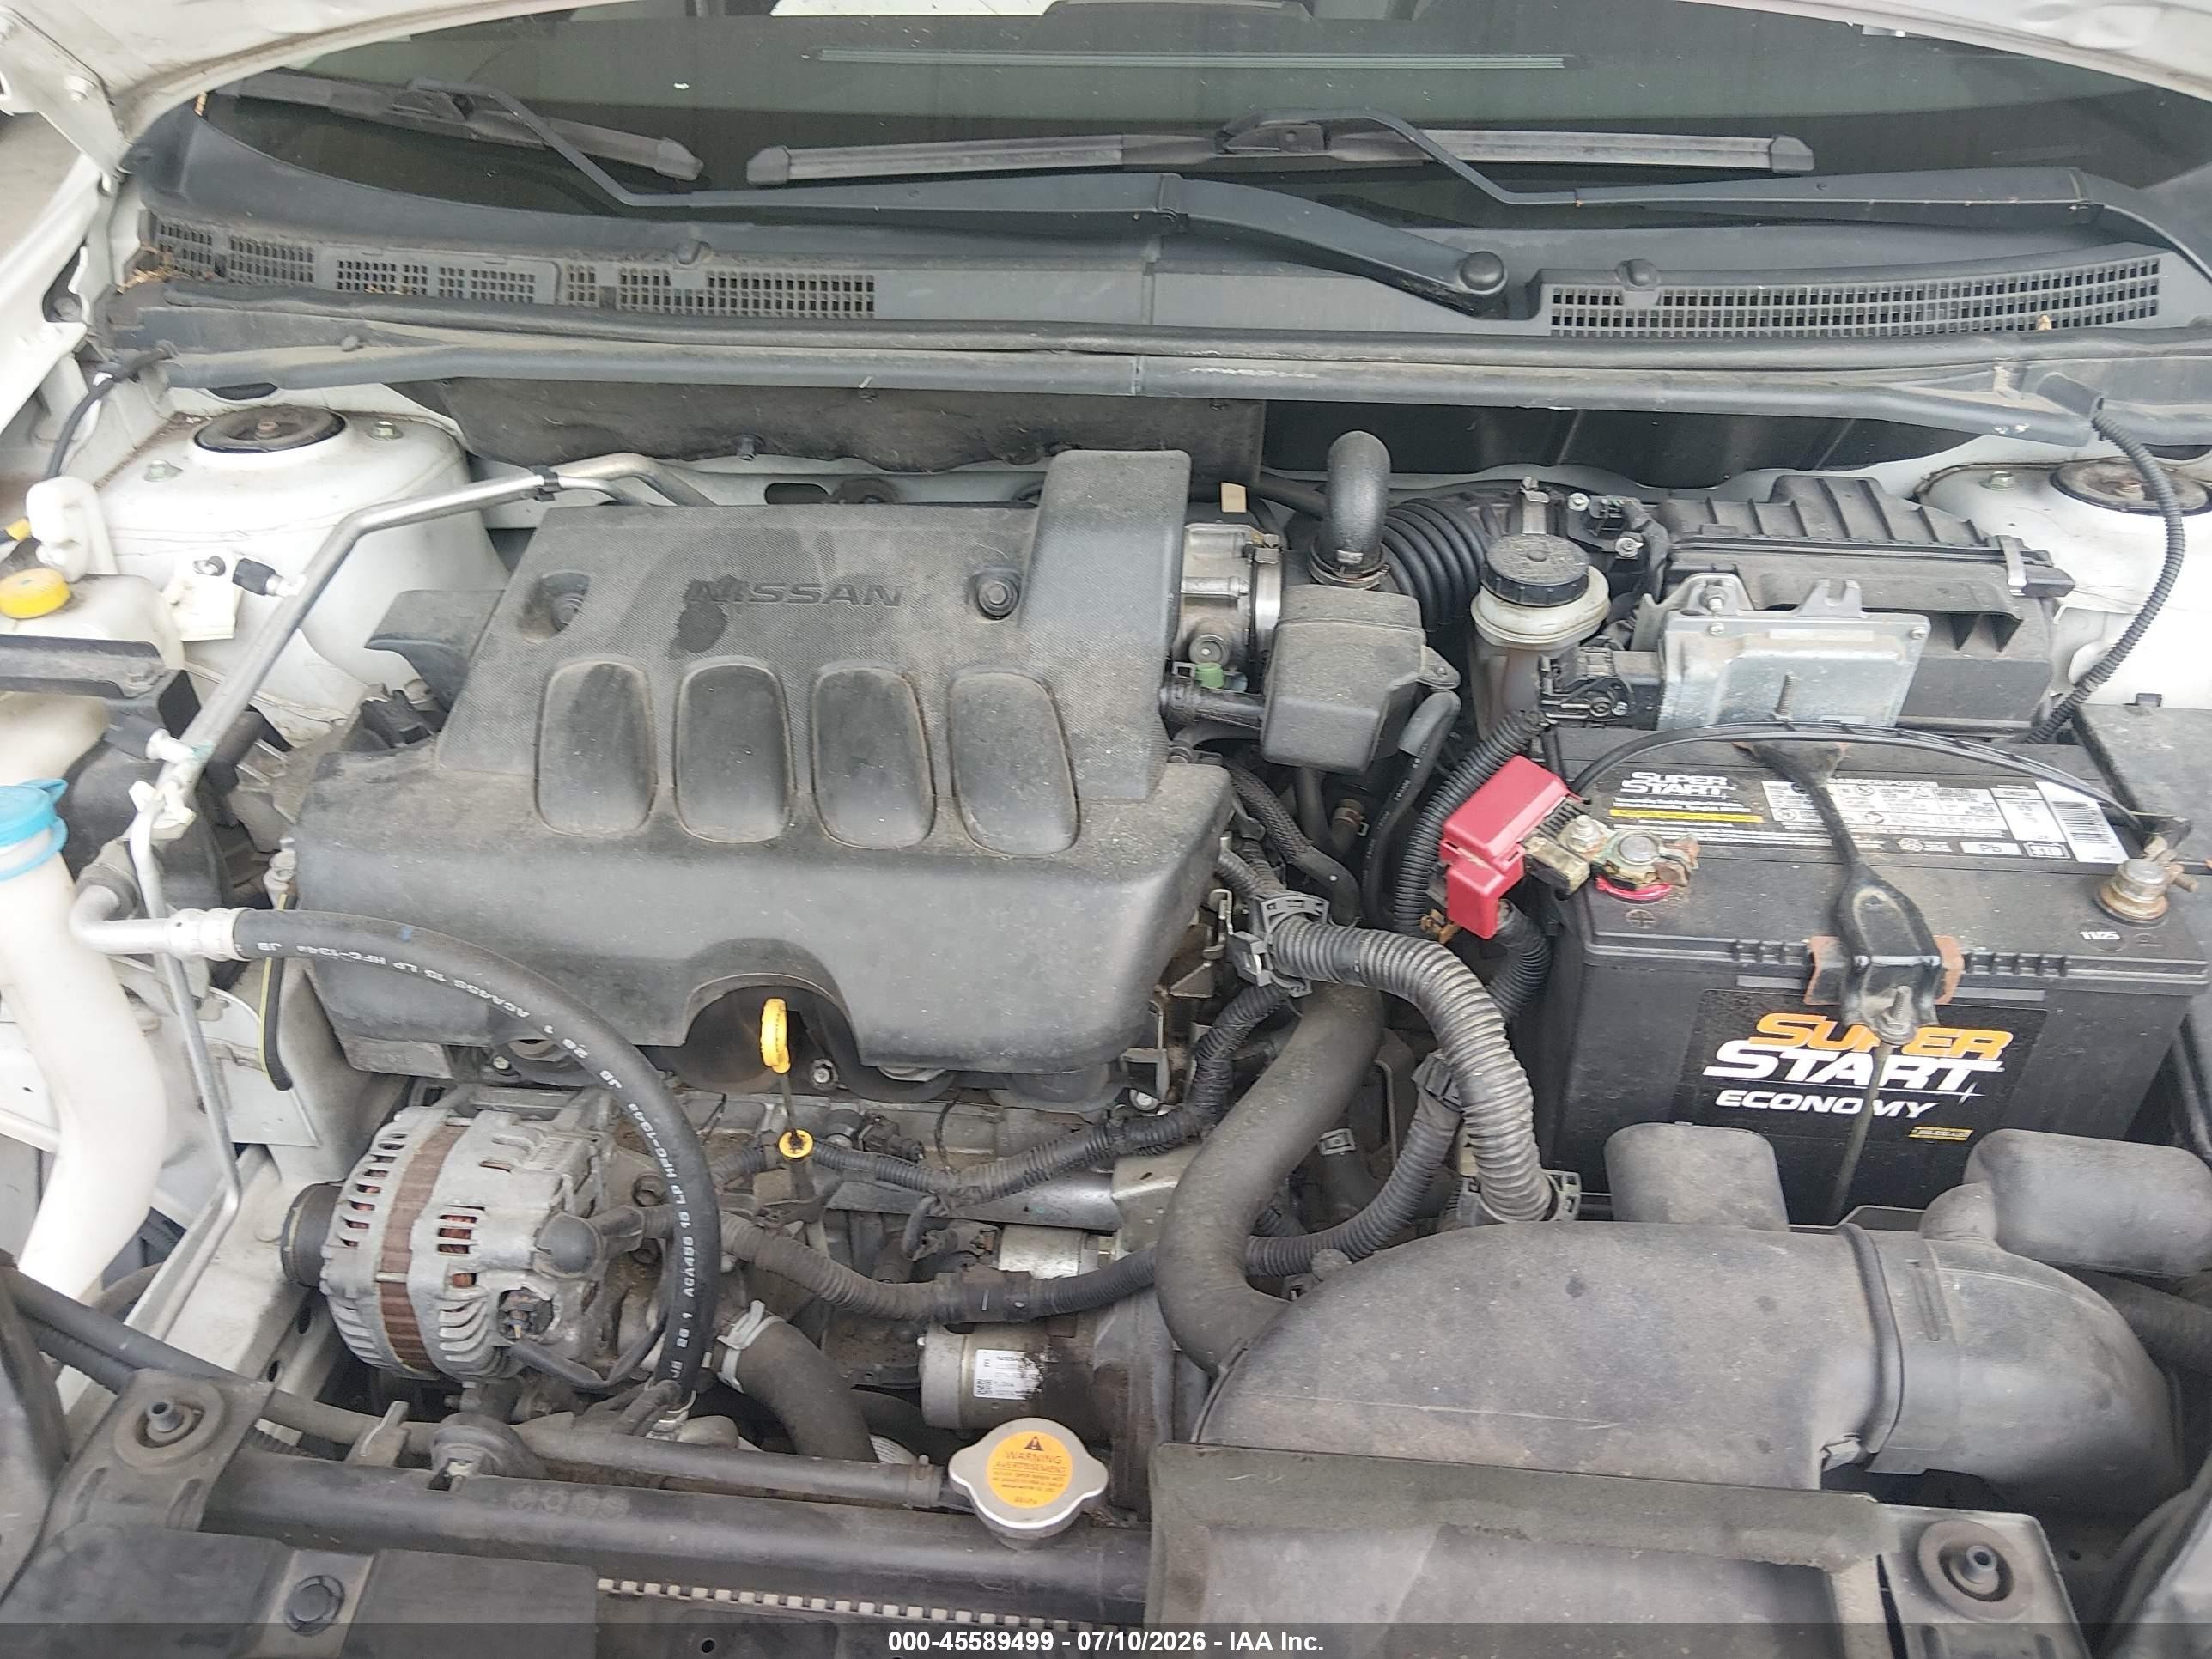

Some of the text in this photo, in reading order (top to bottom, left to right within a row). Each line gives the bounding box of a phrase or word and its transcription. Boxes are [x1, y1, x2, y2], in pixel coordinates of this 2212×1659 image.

[684, 580, 904, 607] NISSAN
[1620, 780, 1736, 796] START
[1632, 771, 1729, 786] SUPER
[1702, 1039, 2006, 1091] START
[1715, 1089, 1940, 1119] ECONOMY
[1005, 1450, 1063, 1464] WARNING
